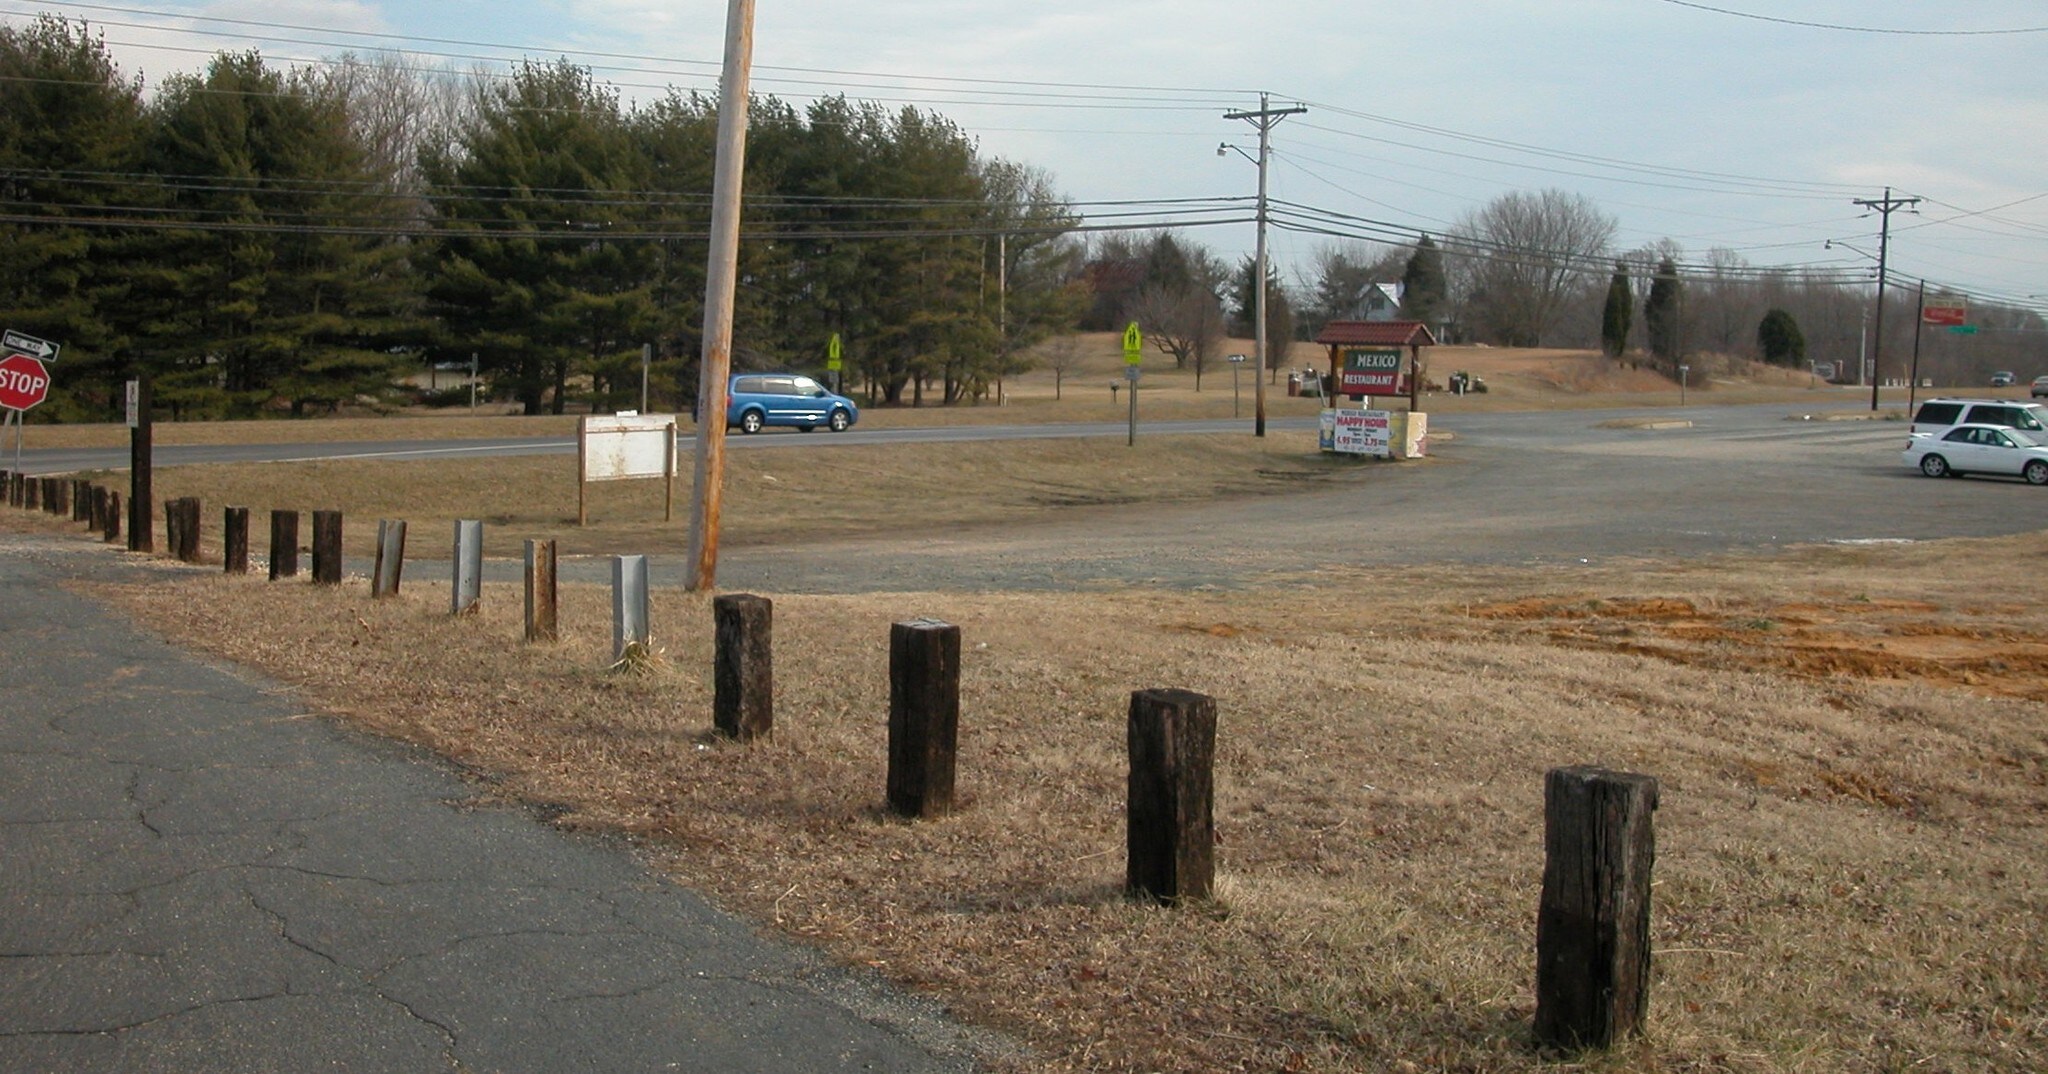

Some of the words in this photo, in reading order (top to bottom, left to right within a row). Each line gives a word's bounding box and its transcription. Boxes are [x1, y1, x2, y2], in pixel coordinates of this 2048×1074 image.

[1357, 354, 1396, 367] MEXICO
[0, 368, 44, 395] STOP
[1344, 374, 1393, 385] RESTAURANT
[1337, 416, 1362, 426] HAPPY
[1364, 418, 1387, 428] HOUR
